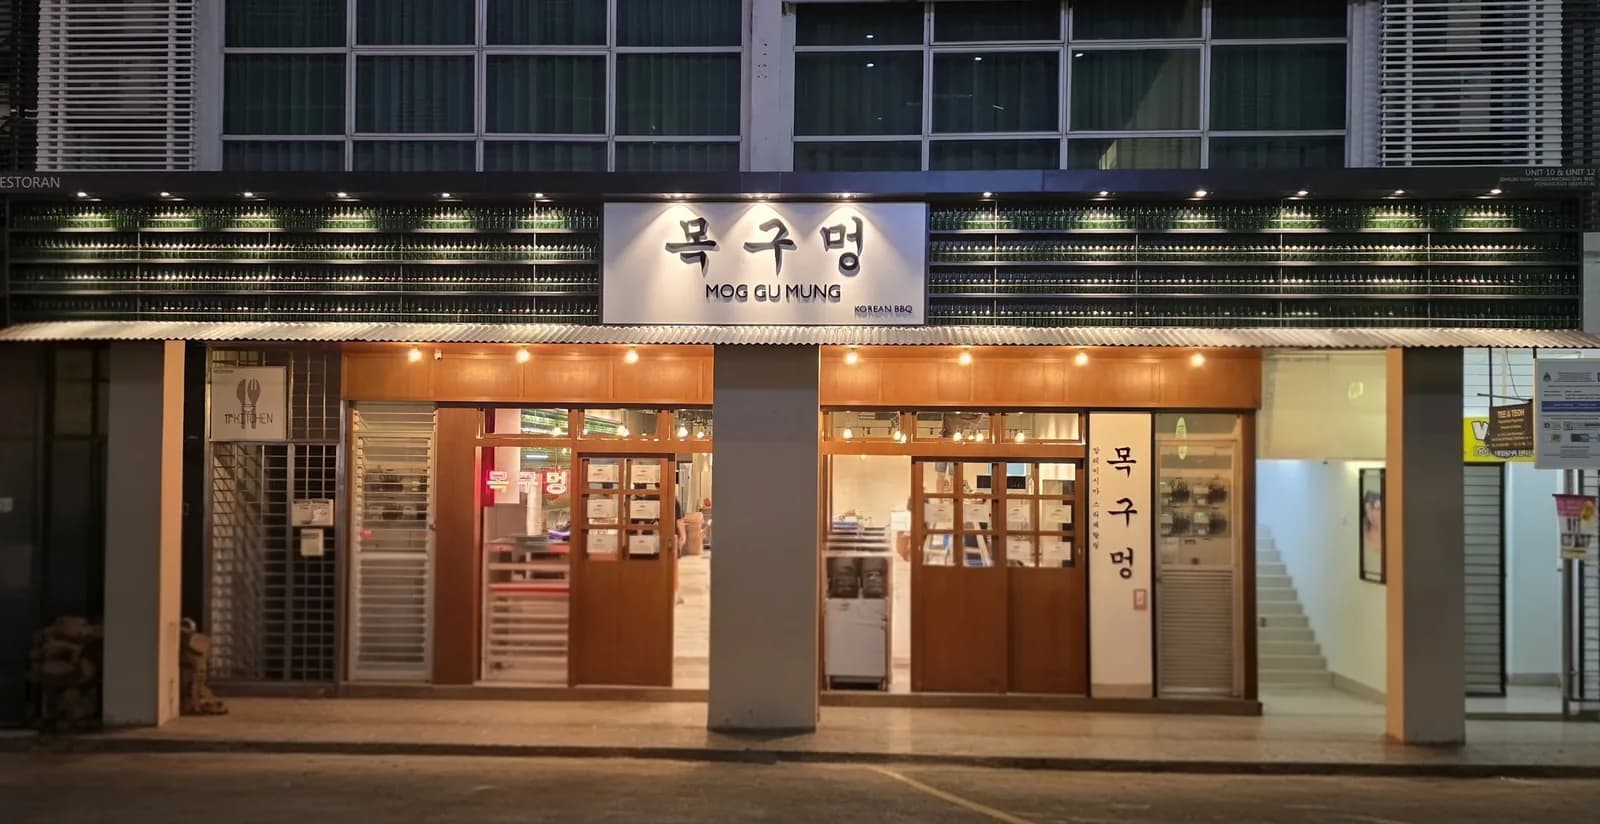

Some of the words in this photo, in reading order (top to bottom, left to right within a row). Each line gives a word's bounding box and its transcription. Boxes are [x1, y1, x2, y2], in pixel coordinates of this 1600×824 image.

[1525, 168, 1543, 176] UNIT
[1546, 168, 1556, 176] 10
[1565, 168, 1584, 176] UNIT
[705, 284, 748, 300] MOG
[754, 284, 781, 300] GU
[785, 284, 841, 300] MUNG
[854, 304, 892, 313] KOREAN
[894, 304, 913, 313] BBQ
[1106, 446, 1138, 579] 목구멍
